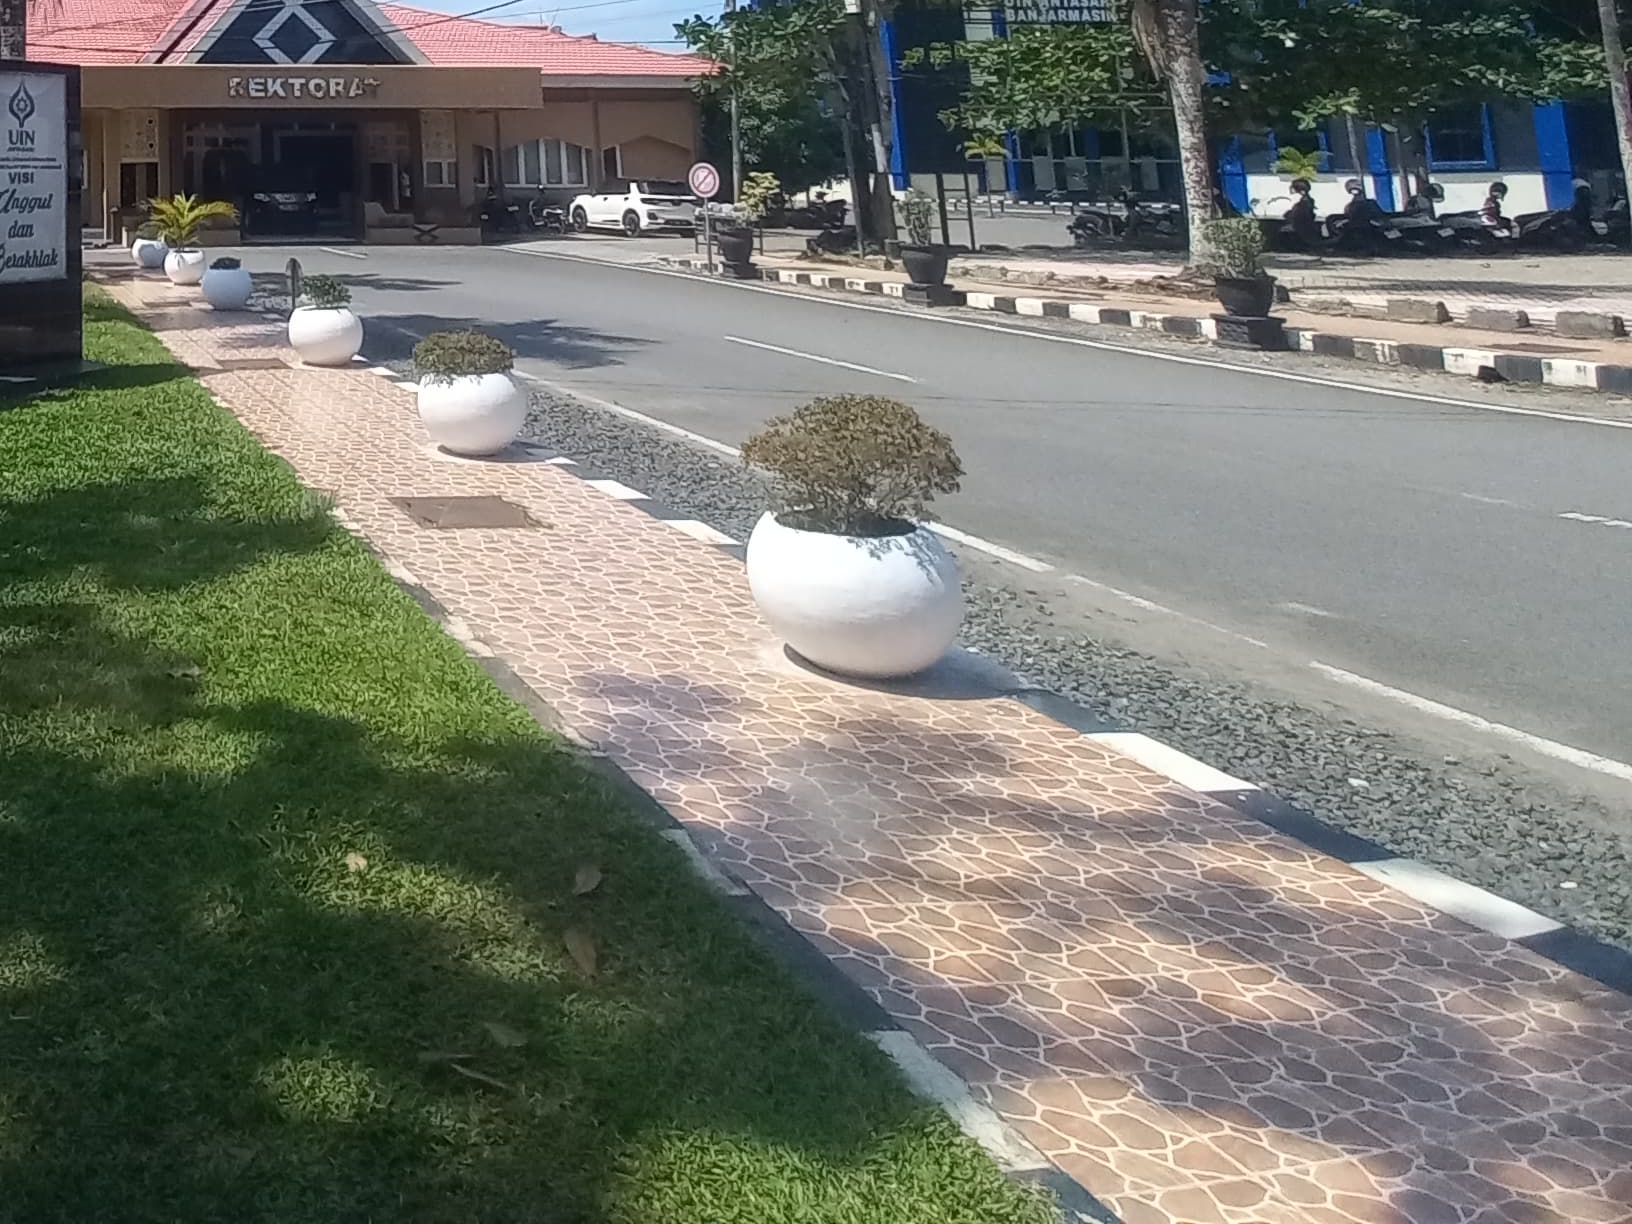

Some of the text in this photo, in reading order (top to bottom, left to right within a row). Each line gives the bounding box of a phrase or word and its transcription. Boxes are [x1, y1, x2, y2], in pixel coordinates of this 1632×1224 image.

[228, 77, 381, 98] REKTORAT
[8, 129, 35, 146] UIN
[8, 172, 34, 184] VISI
[8, 219, 34, 238] dan
